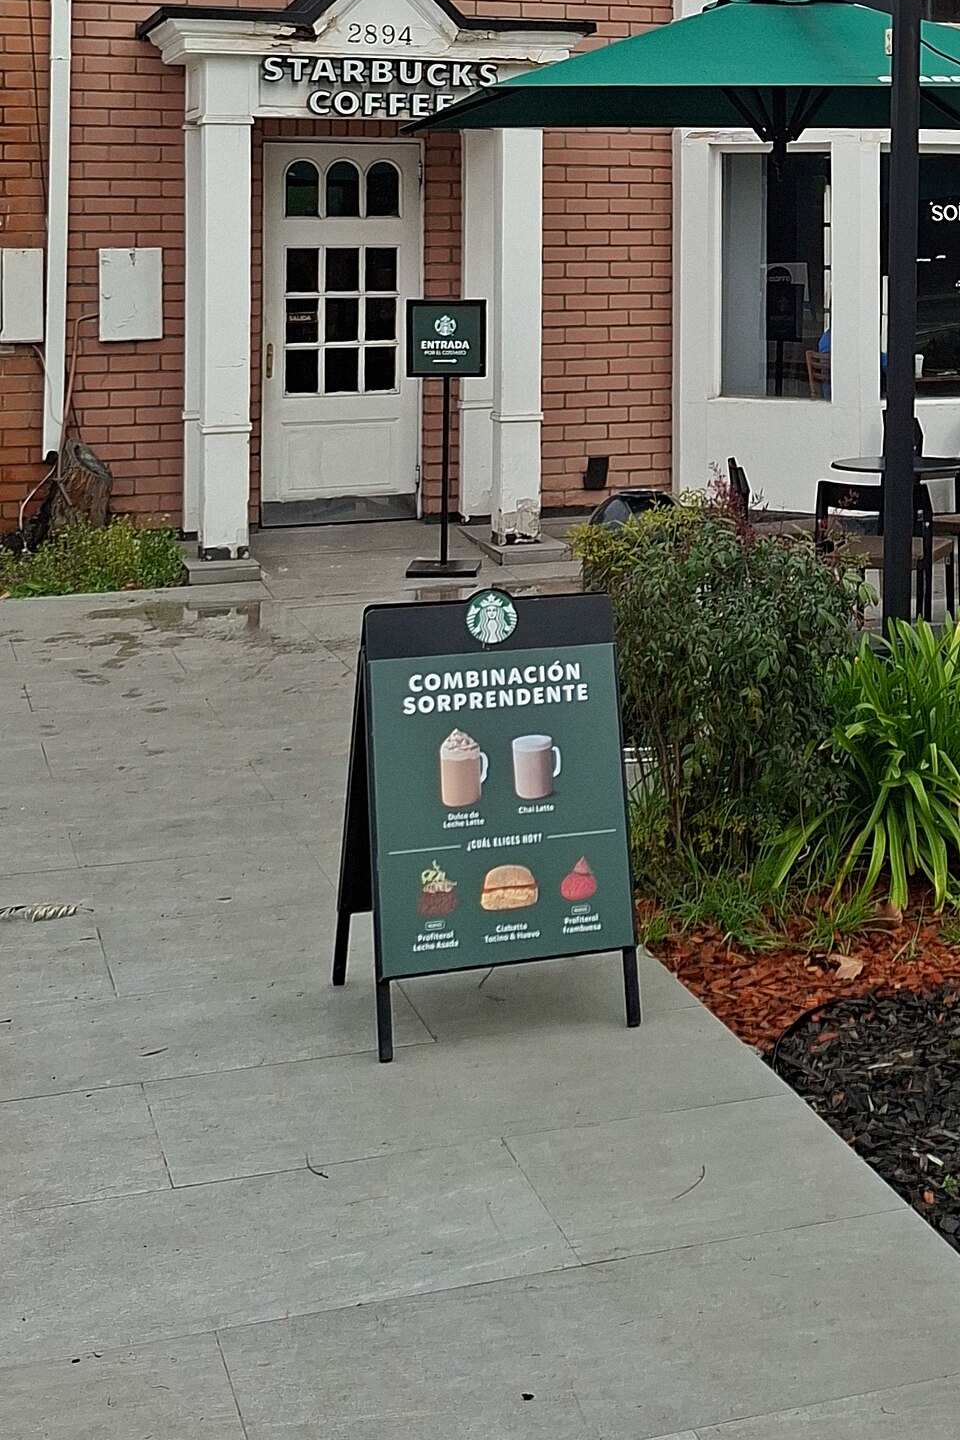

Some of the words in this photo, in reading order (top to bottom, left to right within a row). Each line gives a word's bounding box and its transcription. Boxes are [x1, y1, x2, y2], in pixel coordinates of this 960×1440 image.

[347, 22, 413, 46] 2894
[263, 56, 499, 88] STARBUCKS
[421, 340, 470, 350] ENTRADA
[408, 660, 581, 693] COMBINACIÓN
[402, 683, 589, 715] SORPRENDENTE
[518, 804, 535, 814] Chai
[536, 804, 555, 813] Latte
[447, 812, 469, 821] Dulce
[469, 810, 480, 819] de
[443, 820, 465, 829] Leche
[465, 818, 485, 827] Latte
[493, 834, 521, 848] ELIGES
[522, 832, 543, 844] HOY?
[417, 930, 454, 942] Profiterol
[412, 942, 435, 952] Leche
